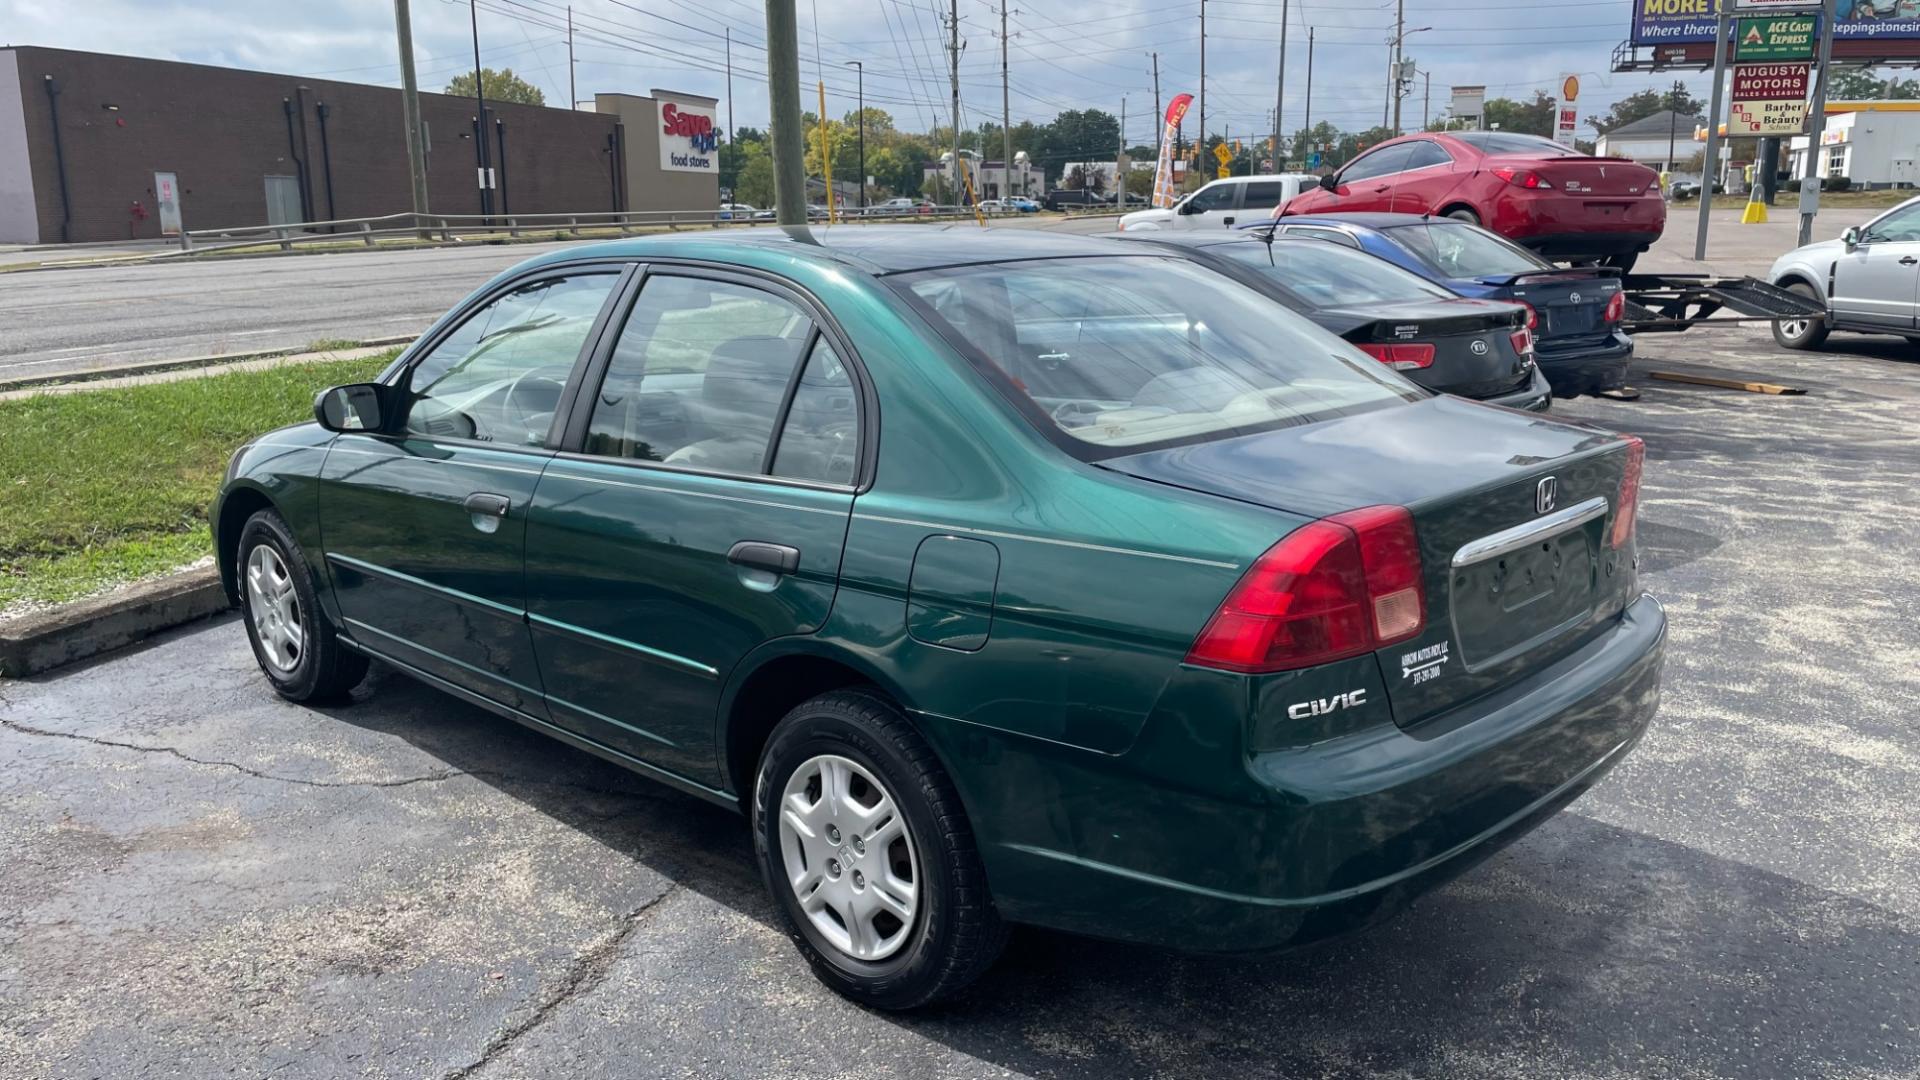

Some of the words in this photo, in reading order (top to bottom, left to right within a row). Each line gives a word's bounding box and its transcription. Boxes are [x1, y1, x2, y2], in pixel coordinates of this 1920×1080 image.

[1644, 0, 1708, 15] MORE
[1642, 25, 1681, 37] Where
[1684, 24, 1734, 38] theray
[1768, 22, 1788, 33] ACE
[1789, 22, 1813, 32] CASH
[1833, 21, 1920, 35] teppingstonesin
[1770, 34, 1808, 44] EXPRESS
[1737, 66, 1806, 77] AUGUSTA
[1740, 78, 1801, 89] MOTORS
[1765, 102, 1803, 112] Barber
[663, 103, 711, 137] Save
[1763, 115, 1801, 125] Beauty
[671, 152, 688, 166] food
[690, 155, 710, 168] stores
[1402, 651, 1418, 667] ARROW
[1288, 688, 1367, 720] CIVIC
